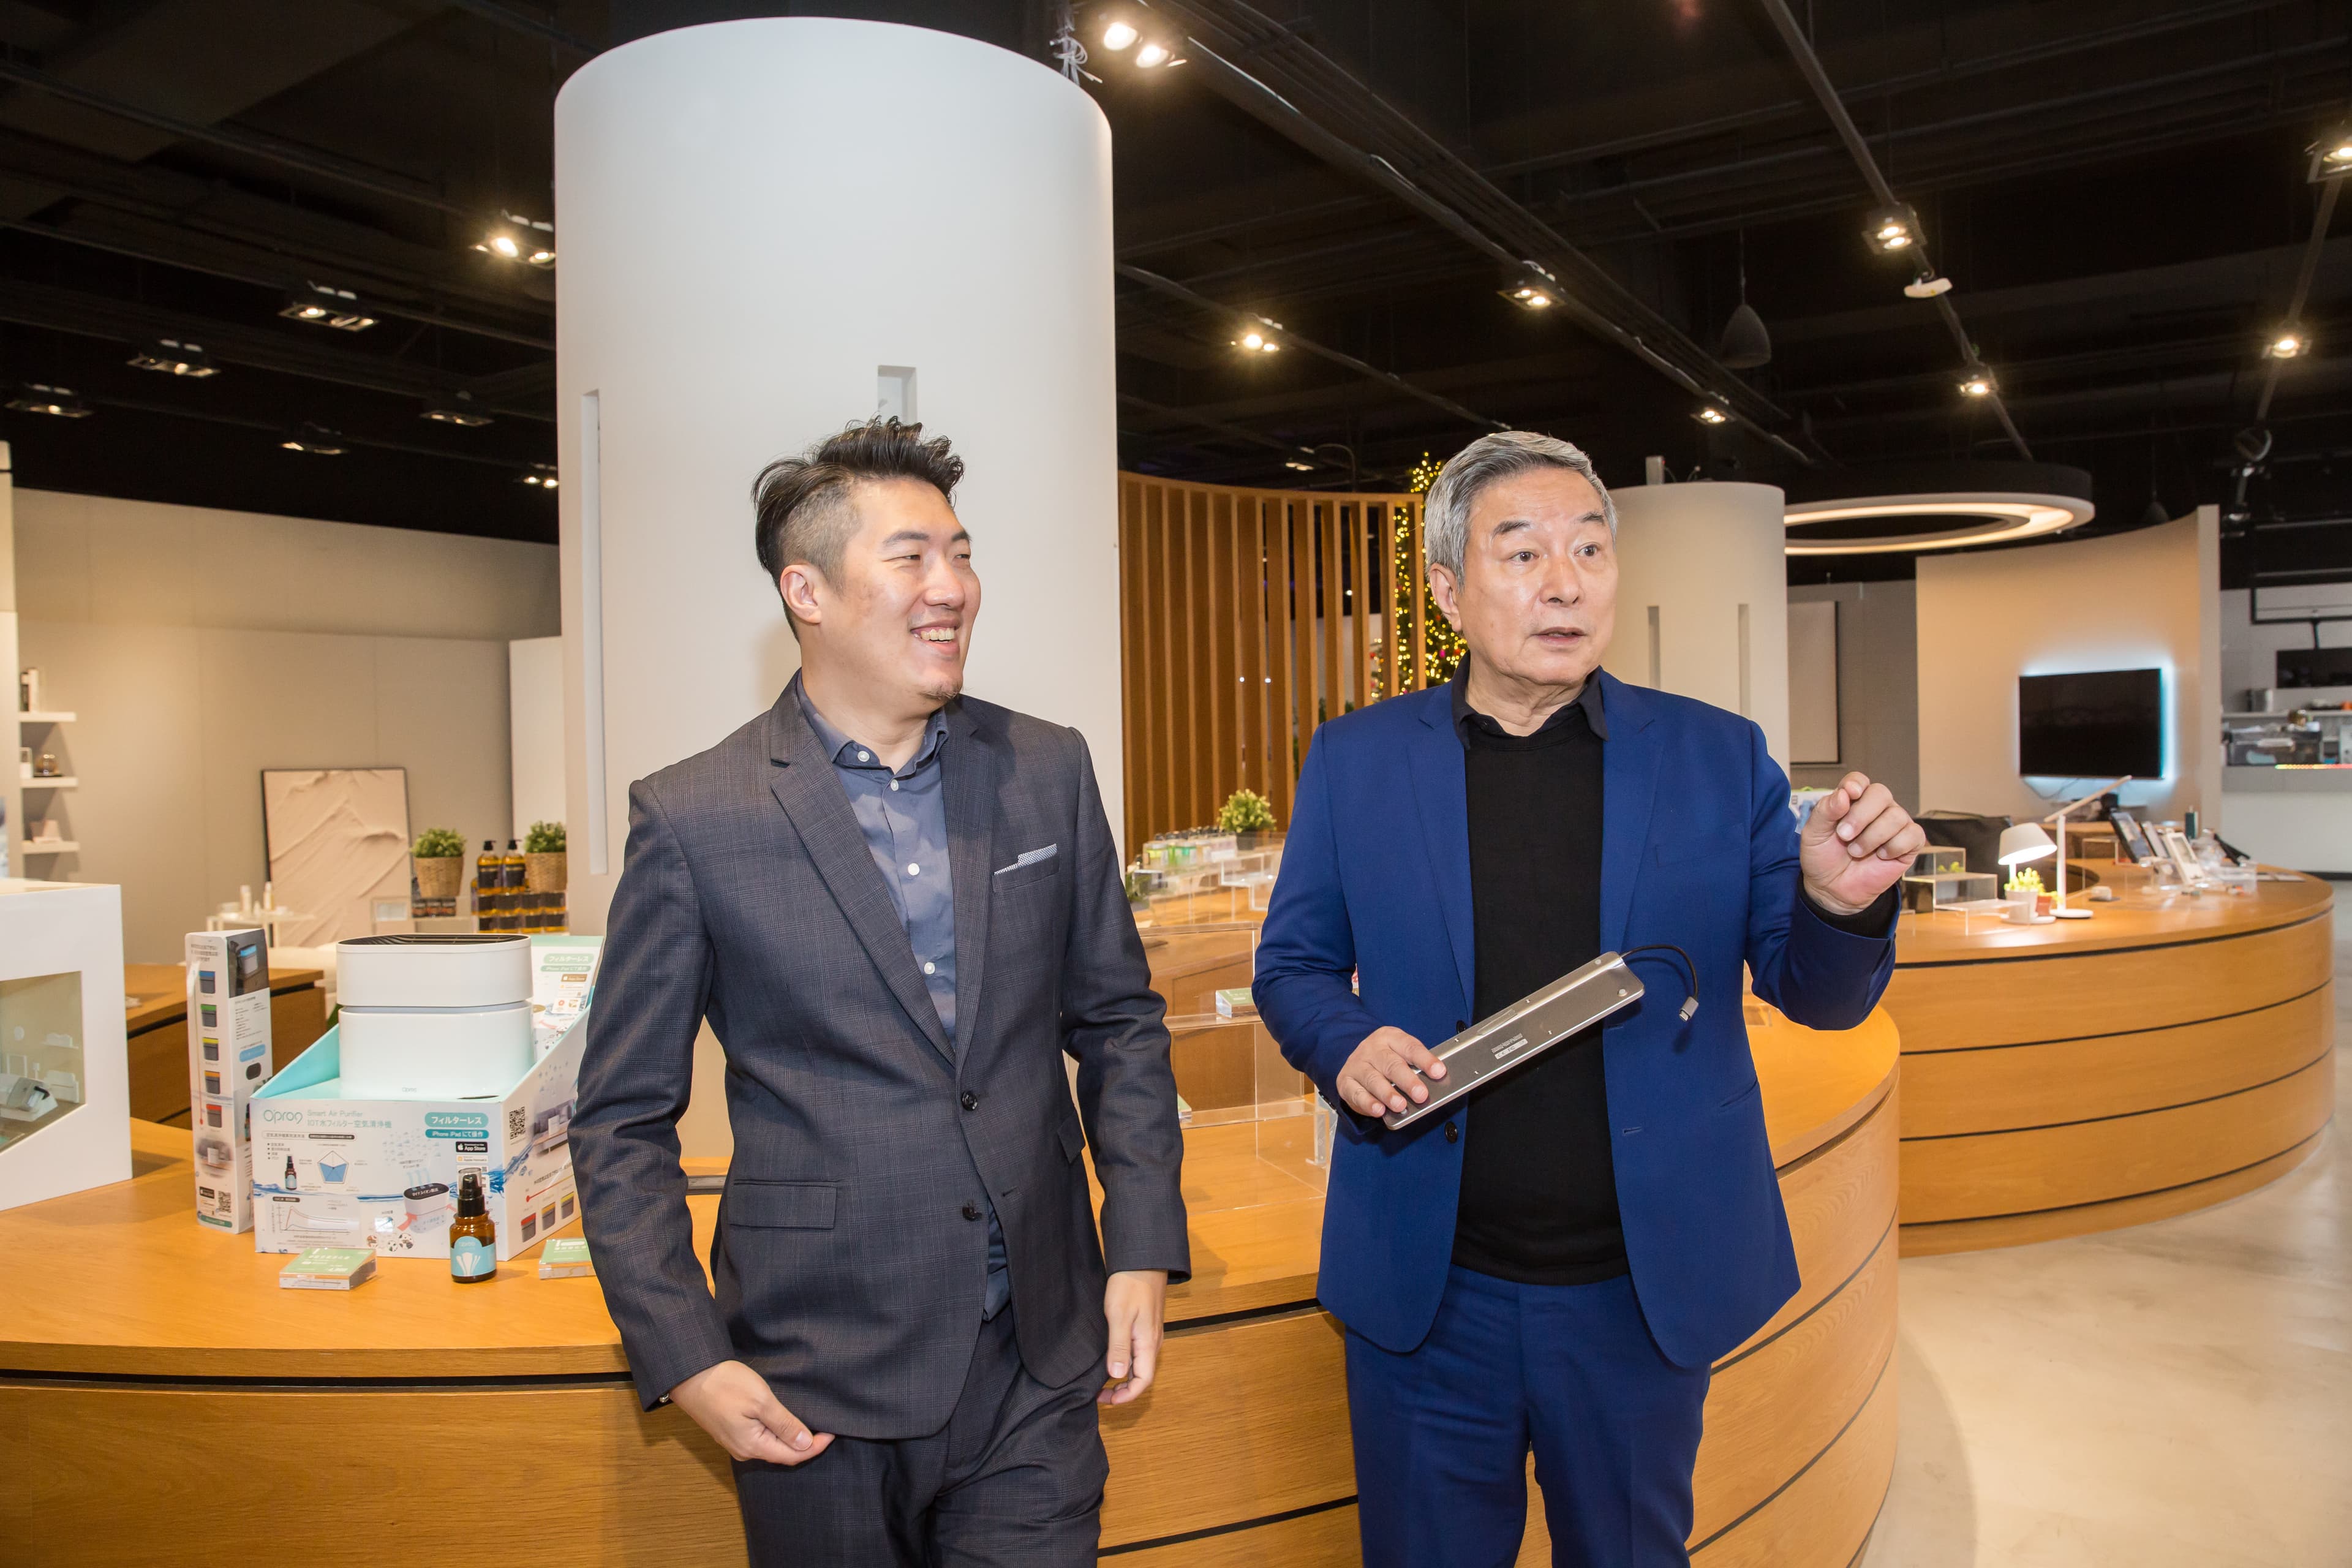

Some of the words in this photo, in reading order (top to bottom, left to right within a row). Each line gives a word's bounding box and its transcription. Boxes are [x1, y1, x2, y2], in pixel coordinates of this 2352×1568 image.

[431, 1116, 482, 1125] フィルターレス
